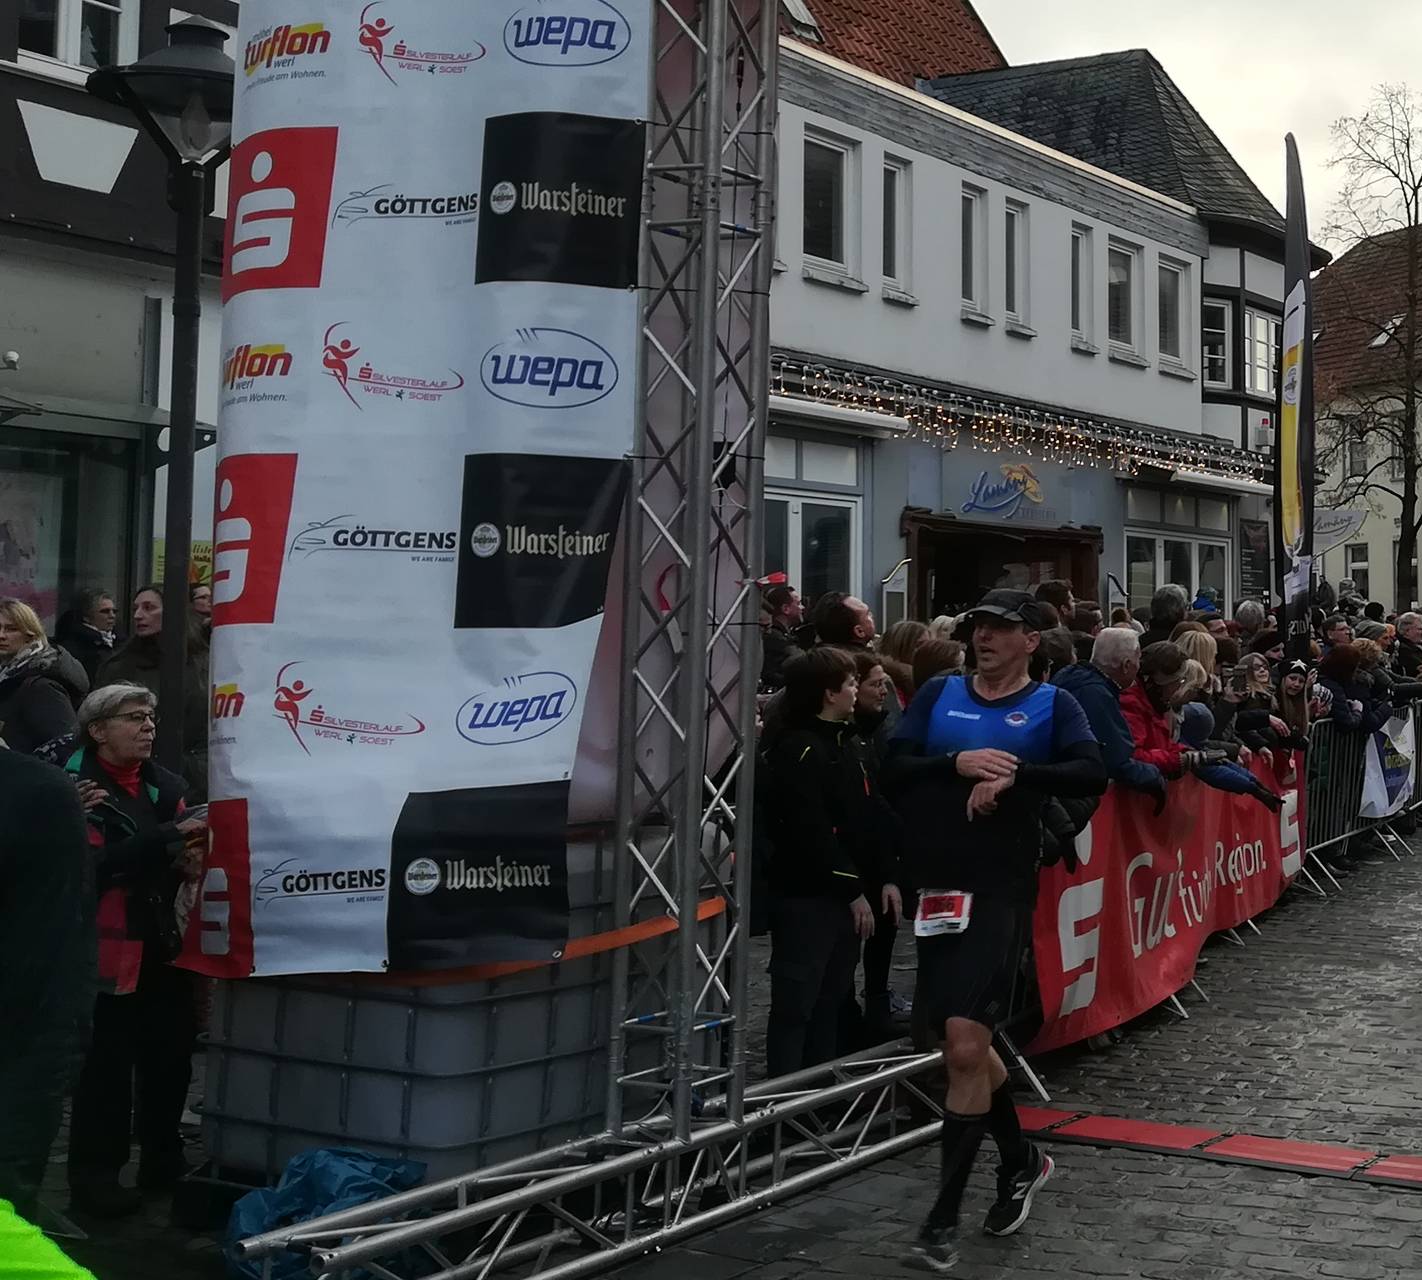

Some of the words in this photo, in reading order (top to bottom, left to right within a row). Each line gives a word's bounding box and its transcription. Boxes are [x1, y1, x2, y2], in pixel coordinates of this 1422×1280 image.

[243, 24, 331, 70] turflon
[513, 16, 616, 54] wepa
[273, 56, 295, 68] werl
[406, 49, 474, 61] SILVESTERLAUF
[398, 62, 426, 72] WERL
[439, 66, 468, 74] SOEST
[373, 192, 478, 215] GÖTTGENS
[520, 181, 626, 218] Warsteiner
[372, 373, 448, 388] SILVESTERLAUF
[491, 355, 604, 396] wepa
[363, 385, 392, 397] WERL
[408, 391, 442, 401] SOEST
[332, 526, 456, 550] GÖTTGENS
[506, 524, 610, 560] Warsteiner
[324, 714, 404, 732] SILVESTERLAUF
[468, 690, 567, 732] wepa
[314, 729, 343, 741] WERL
[359, 736, 395, 745] SOEST
[282, 868, 386, 893] GÖTTGENS
[445, 856, 551, 892] Warsteiner
